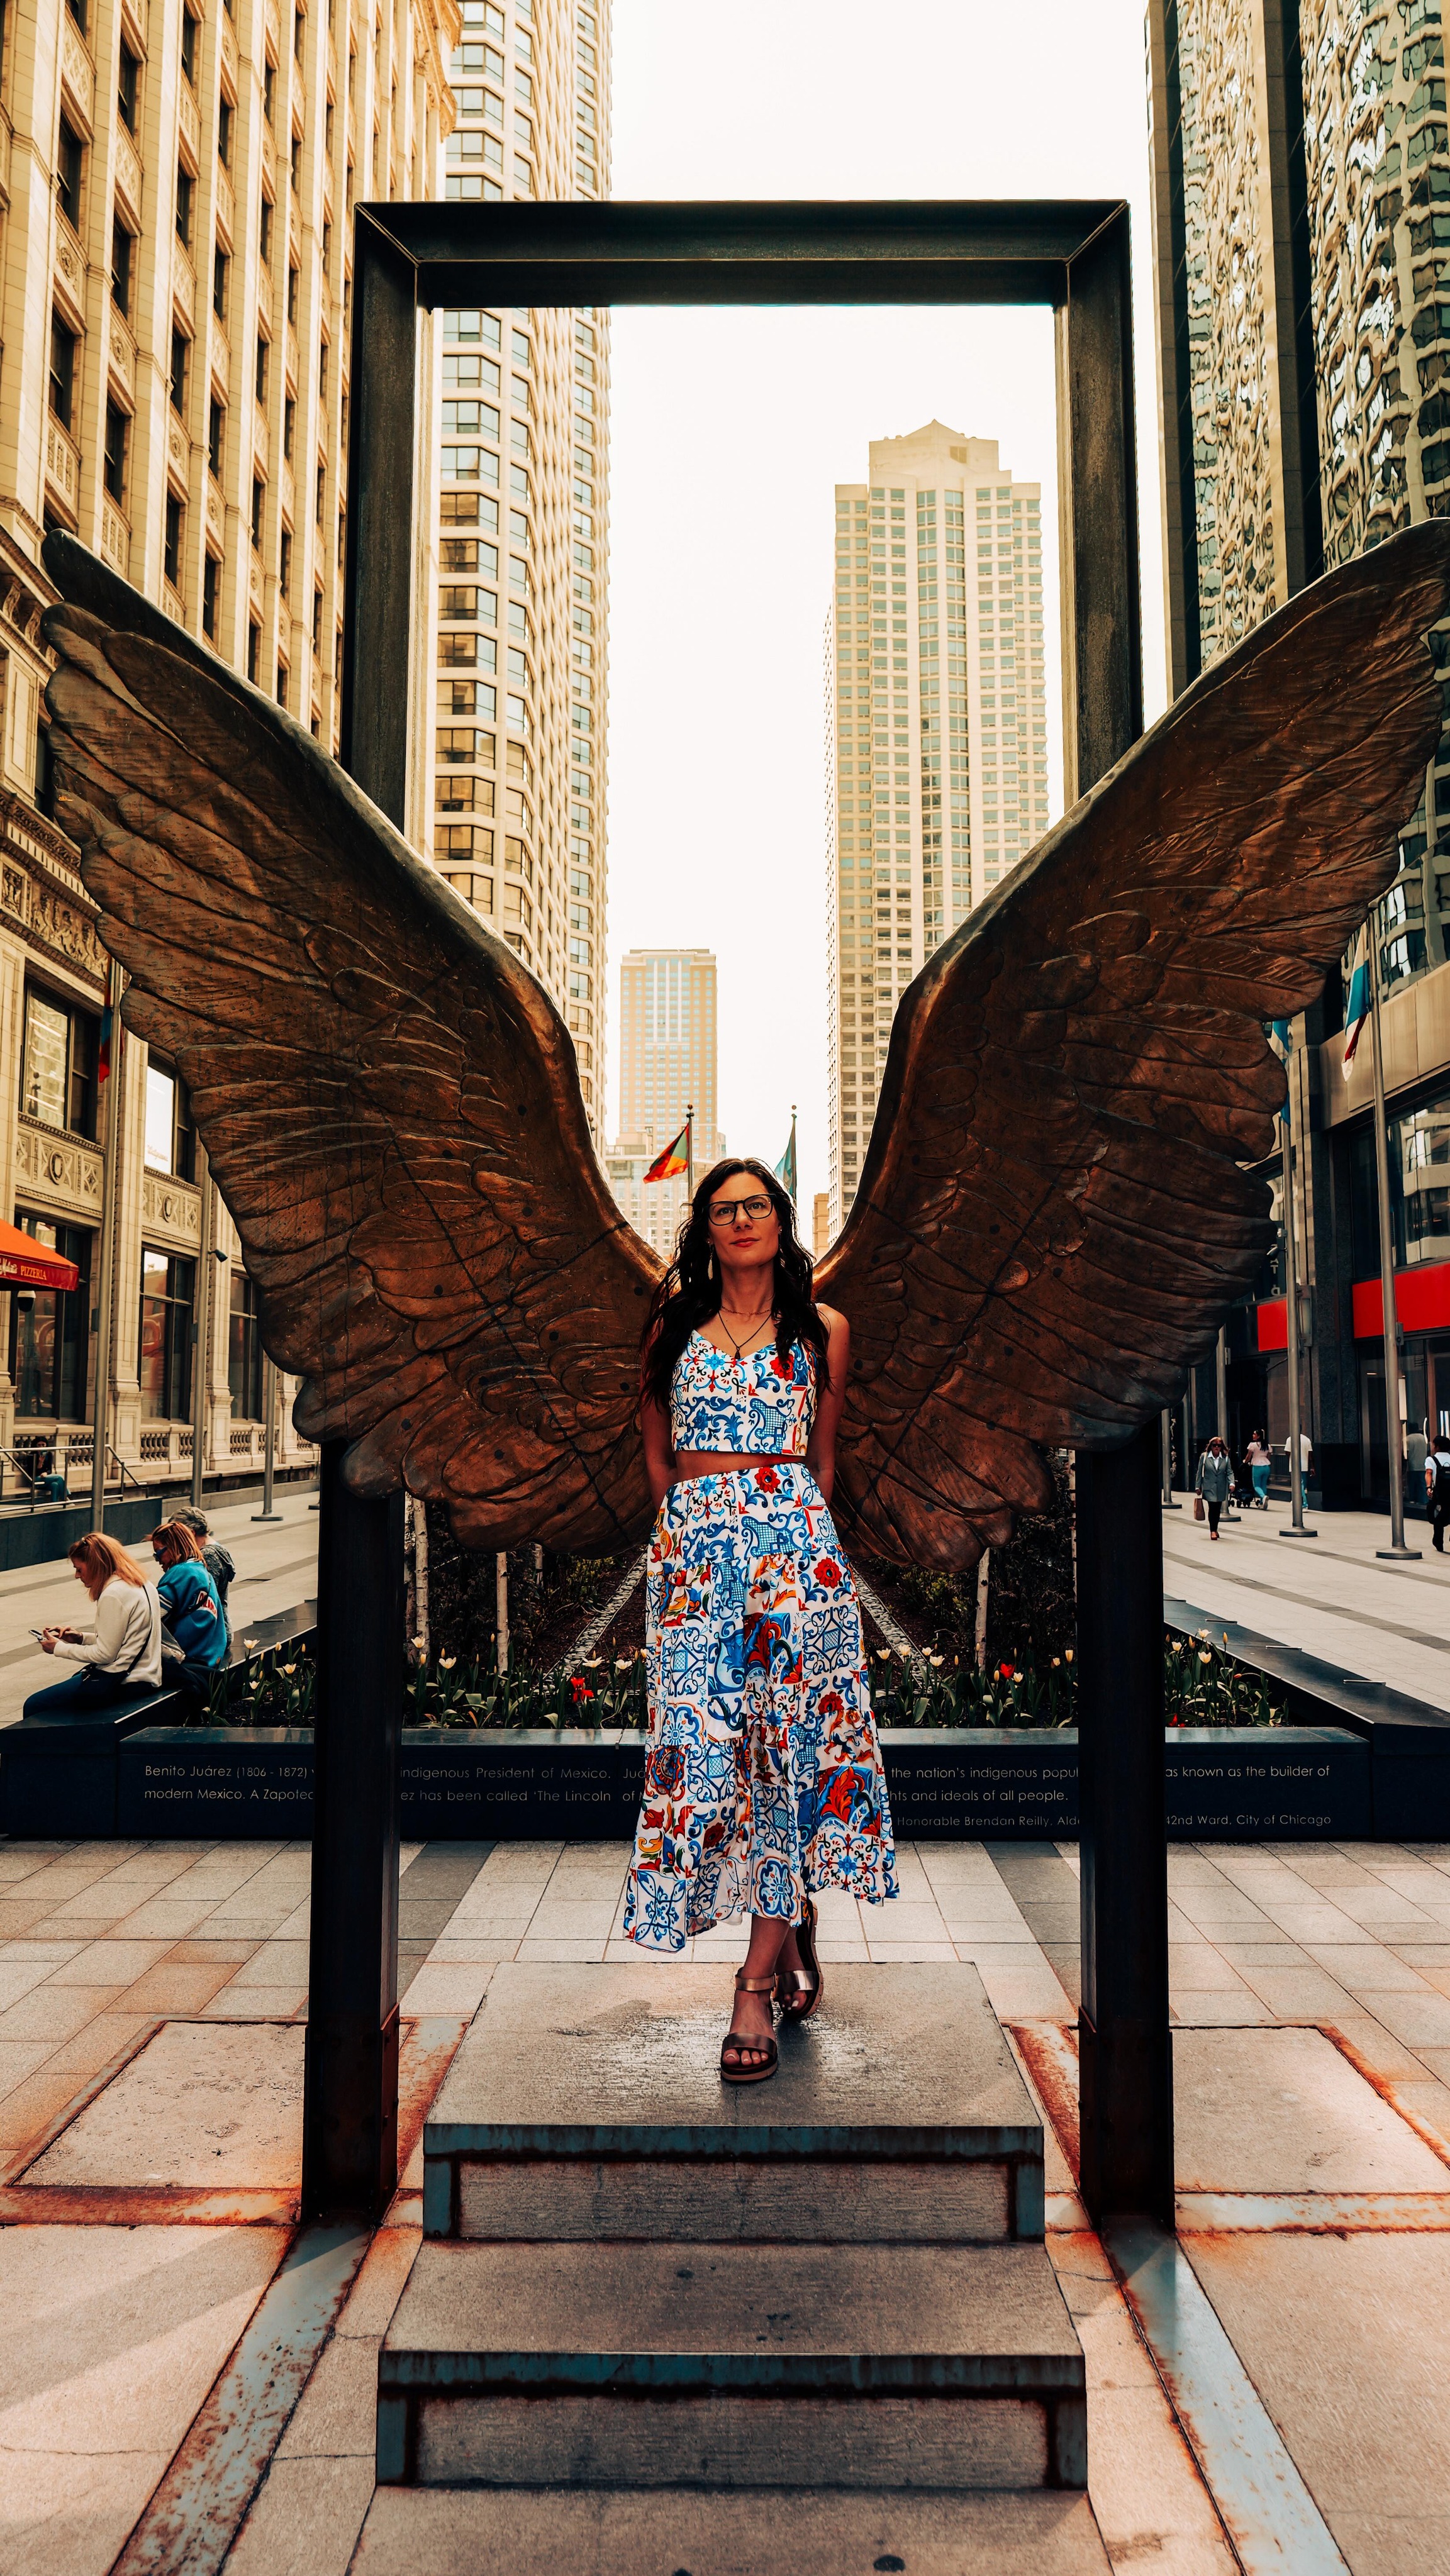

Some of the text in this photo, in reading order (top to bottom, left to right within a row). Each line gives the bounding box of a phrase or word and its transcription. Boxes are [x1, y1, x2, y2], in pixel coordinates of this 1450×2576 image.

[21, 1265, 47, 1280] PIZZERIA
[145, 1765, 186, 1776] Benito
[190, 1765, 231, 1777] Juárez
[237, 1767, 266, 1779] (1806
[279, 1767, 307, 1779] 1872)
[400, 1767, 469, 1780] indigenous
[476, 1767, 534, 1779] President
[541, 1767, 554, 1779] of
[560, 1767, 611, 1779] Mexico.
[623, 1767, 646, 1779] Juá
[891, 1767, 912, 1778] the
[970, 1767, 1037, 1780] indigenous
[1042, 1767, 1078, 1780] popul
[1165, 1768, 1178, 1777] as
[1182, 1766, 1224, 1777] known
[1227, 1768, 1241, 1777] as
[1246, 1766, 1266, 1777] the
[1270, 1765, 1313, 1777] builder
[1317, 1765, 1330, 1777] of
[145, 1788, 193, 1799] modern
[197, 1788, 245, 1799] Mexico.
[250, 1789, 259, 1799] A
[263, 1789, 313, 1802] Zapotec
[420, 1790, 442, 1801] has
[447, 1790, 481, 1801] been
[486, 1790, 527, 1801] called
[566, 1790, 611, 1802] Lincoln
[622, 1790, 635, 1801] of
[890, 1790, 908, 1801] hts
[911, 1790, 937, 1801] and
[941, 1790, 979, 1801] ideals
[983, 1789, 995, 1801] of
[1000, 1790, 1014, 1801] all
[1018, 1789, 1068, 1803] people.
[898, 1816, 961, 1826] Honorable
[964, 1816, 1015, 1826] Brendan
[1019, 1816, 1052, 1828] Reilly,
[1057, 1816, 1079, 1826] Ald
[1197, 1815, 1232, 1825] Ward,
[1236, 1814, 1259, 1826] City
[1264, 1814, 1275, 1824] of
[1280, 1814, 1331, 1826] Chicago
